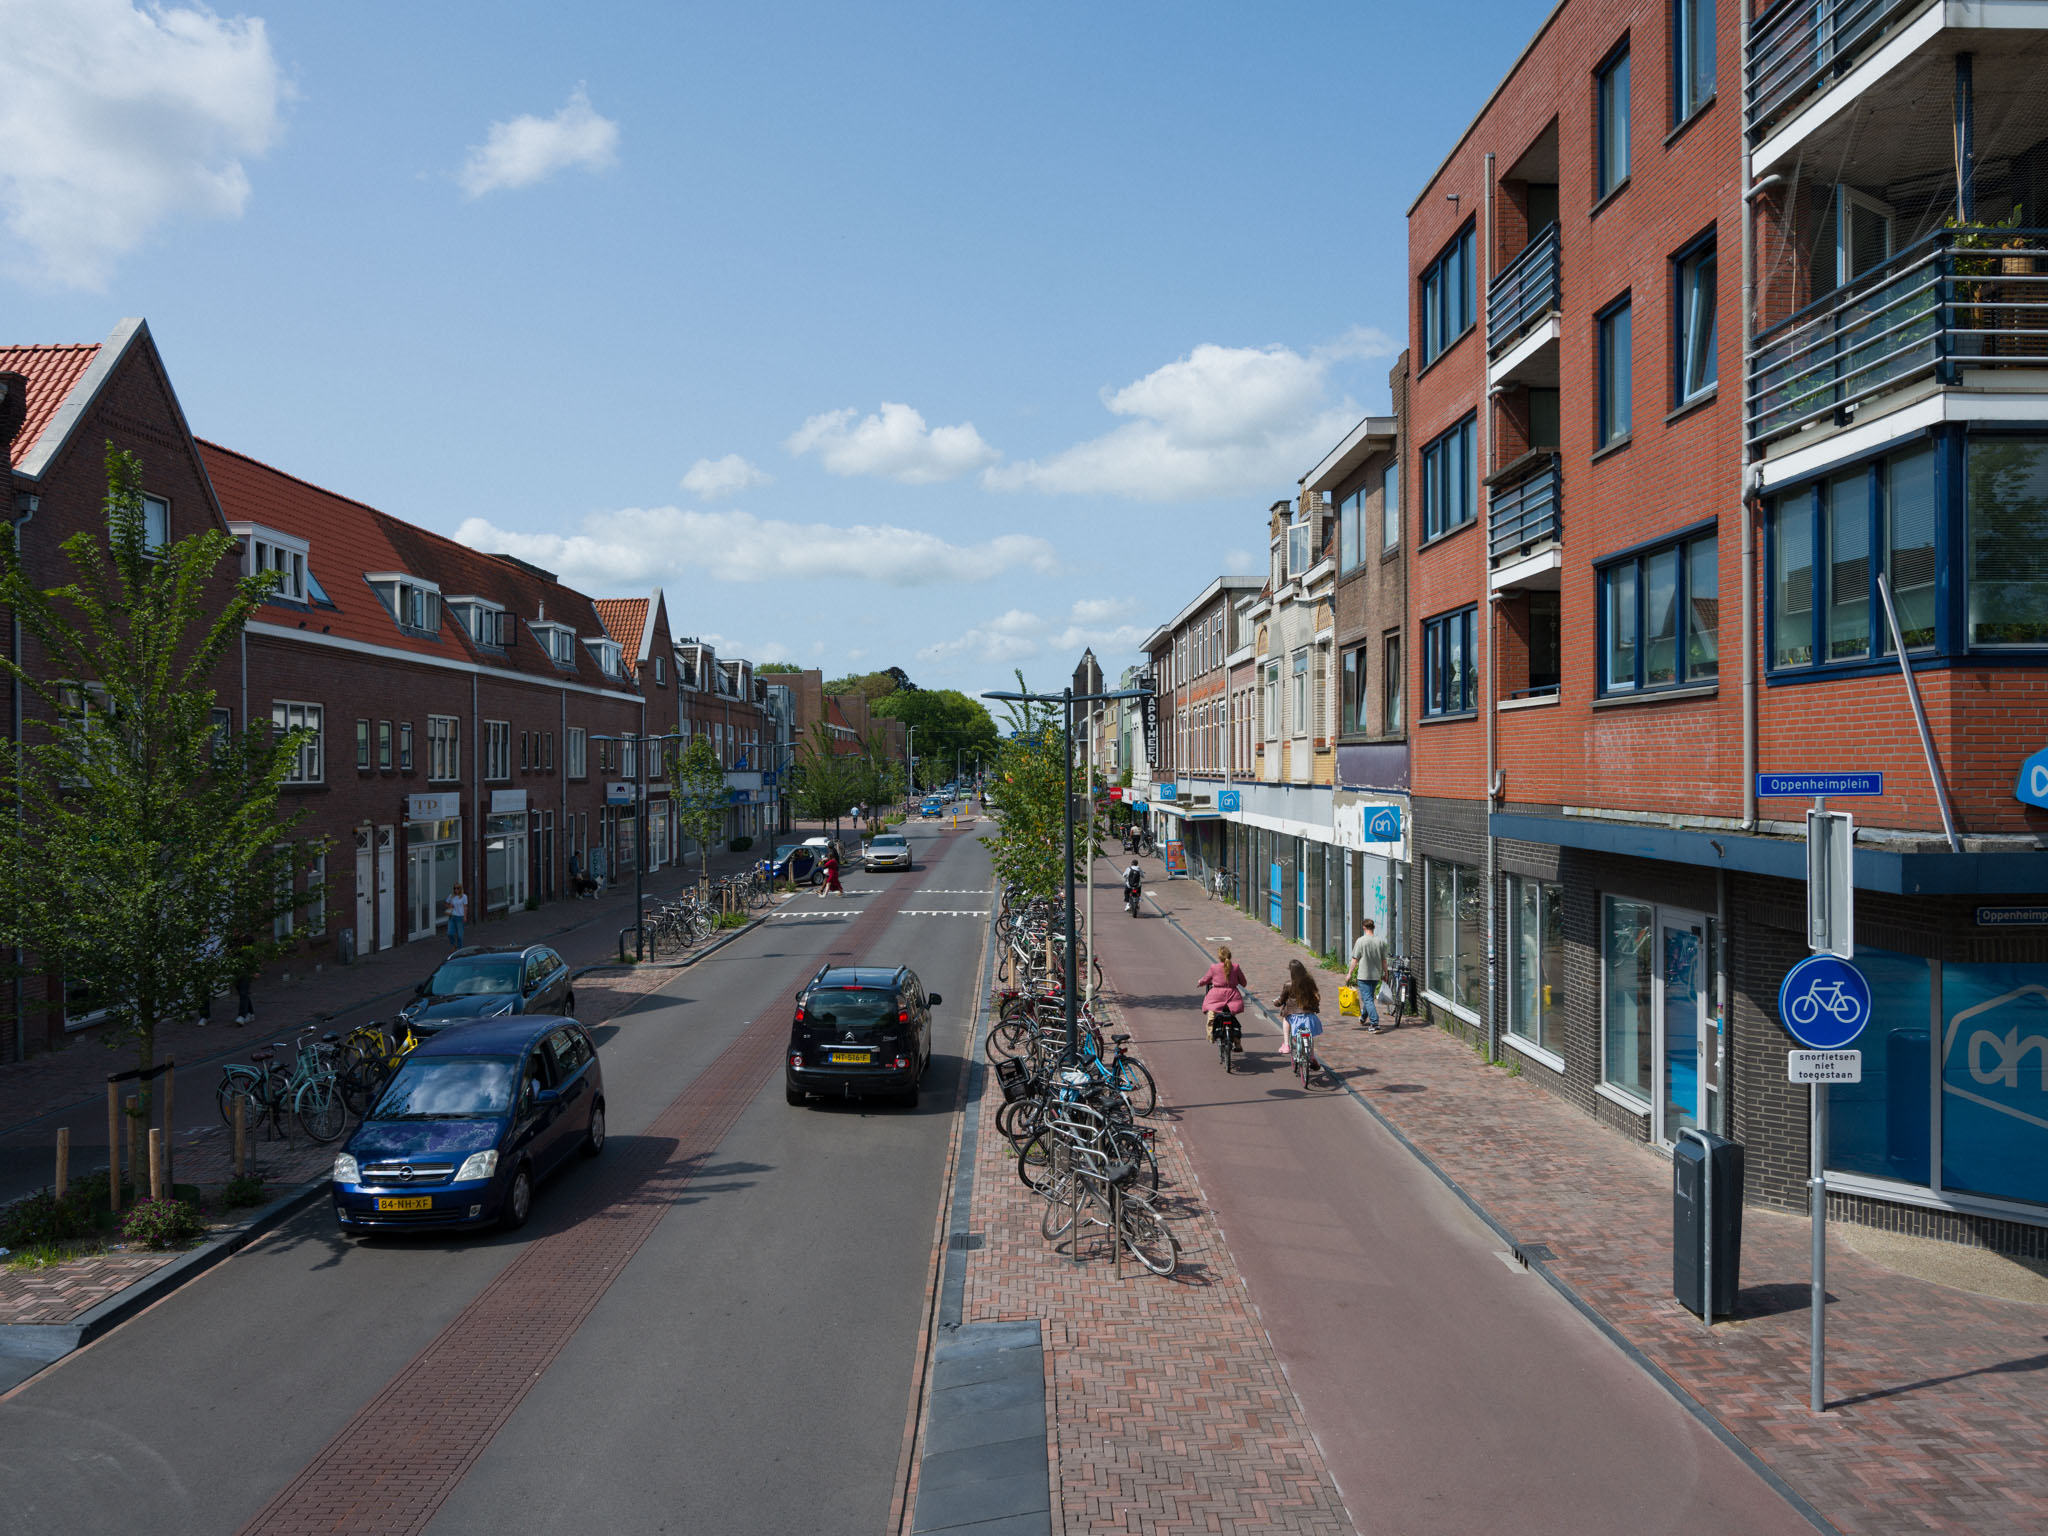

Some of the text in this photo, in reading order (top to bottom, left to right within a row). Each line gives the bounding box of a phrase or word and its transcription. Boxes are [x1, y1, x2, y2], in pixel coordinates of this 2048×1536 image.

[1148, 697, 1156, 762] APOTHEEK
[1771, 779, 1870, 792] Oppenheimplein
[1799, 1053, 1856, 1061] snorfietsen
[1815, 1062, 1835, 1070] niet
[1798, 1071, 1853, 1080] toegestaan
[381, 1199, 429, 1209] 84-NH-XF
